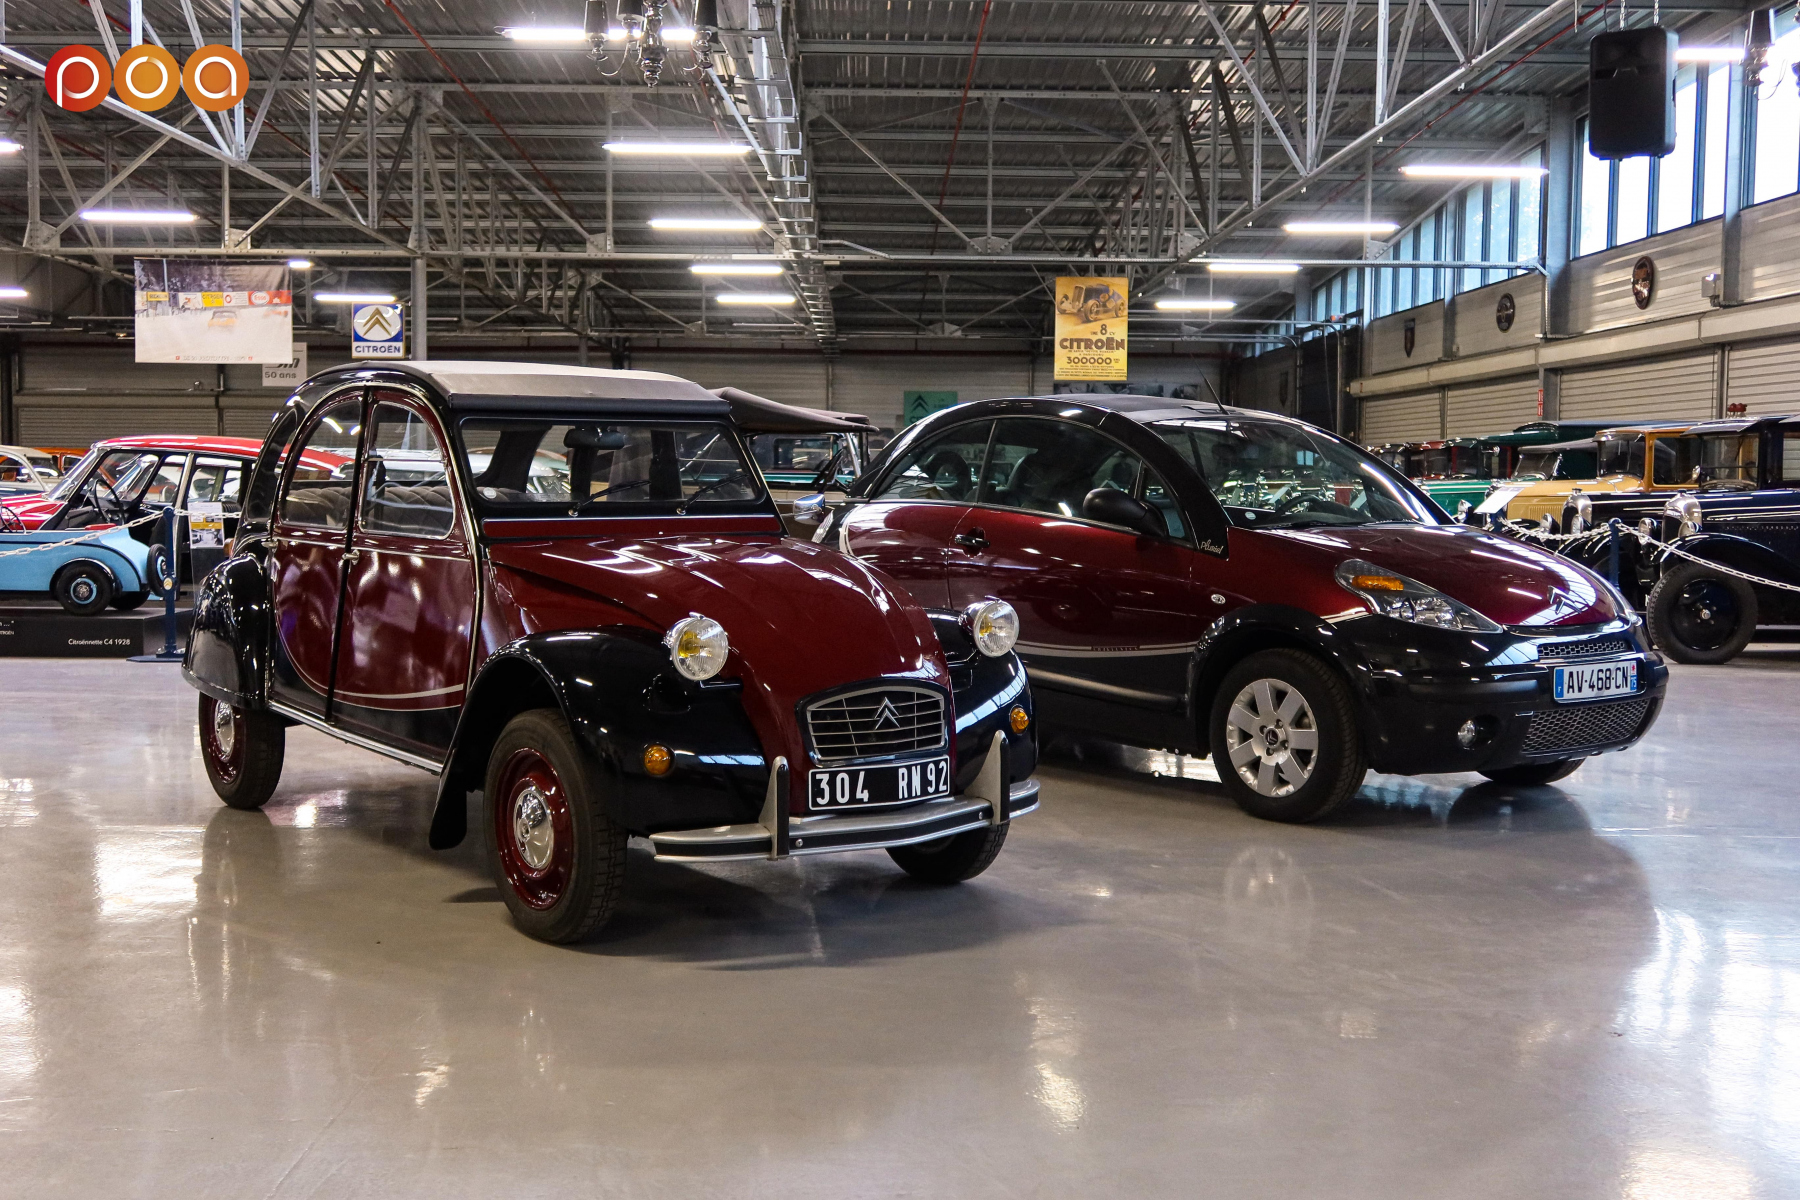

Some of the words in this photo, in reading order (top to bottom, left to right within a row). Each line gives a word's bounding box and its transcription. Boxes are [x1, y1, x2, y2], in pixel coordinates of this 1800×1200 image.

[1100, 323, 1107, 335] 8
[355, 345, 401, 353] CITROËN
[1059, 336, 1126, 350] CITROËN
[1067, 356, 1112, 365] 300000
[264, 371, 277, 379] 50
[1567, 666, 1629, 694] AV-468-CN
[815, 771, 869, 805] 304
